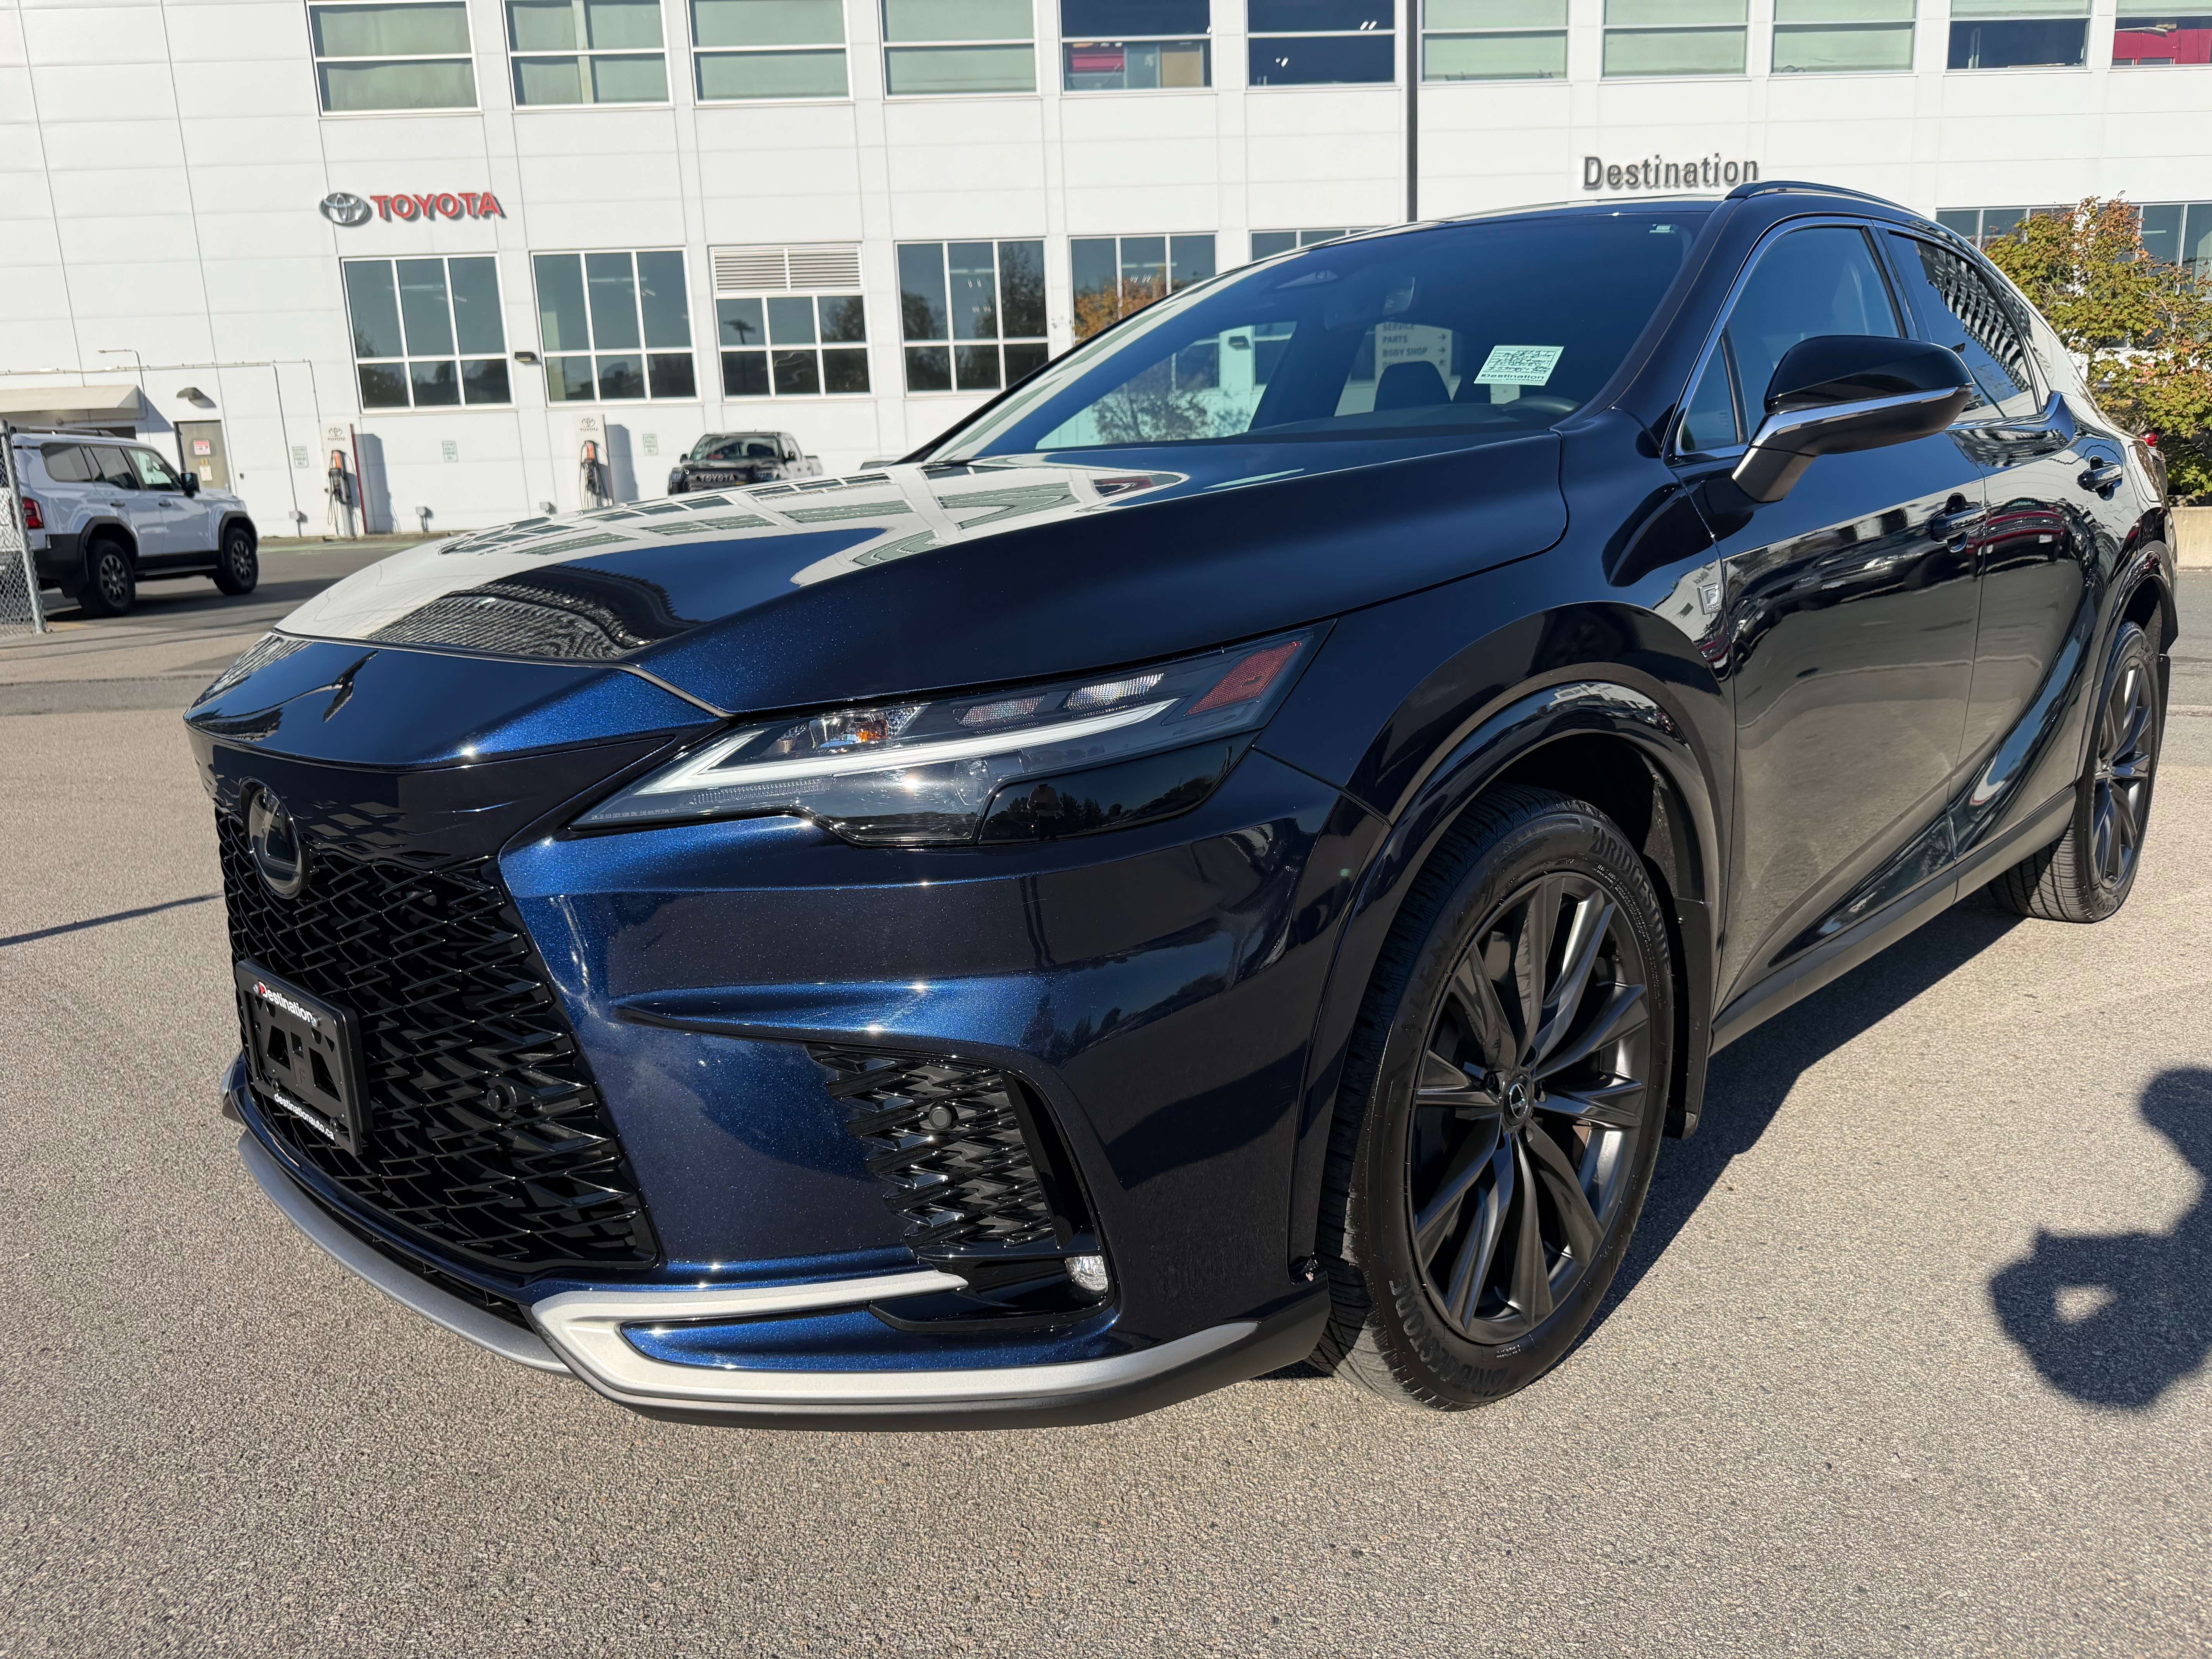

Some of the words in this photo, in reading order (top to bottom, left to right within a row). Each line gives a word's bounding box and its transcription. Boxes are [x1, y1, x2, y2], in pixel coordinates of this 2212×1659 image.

[1583, 153, 1758, 188] Destination
[370, 192, 505, 219] TOYOTA
[1382, 335, 1407, 343] PARTS
[1382, 348, 1404, 357] BODY
[1406, 347, 1428, 356] SHOP
[699, 473, 735, 483] TOYOTA
[1589, 825, 1671, 971] BRIDGESTONE
[258, 981, 313, 1023] Destination
[274, 1092, 335, 1140] destinationauto.ca
[1388, 1272, 1509, 1397] BRIDGESTONE
